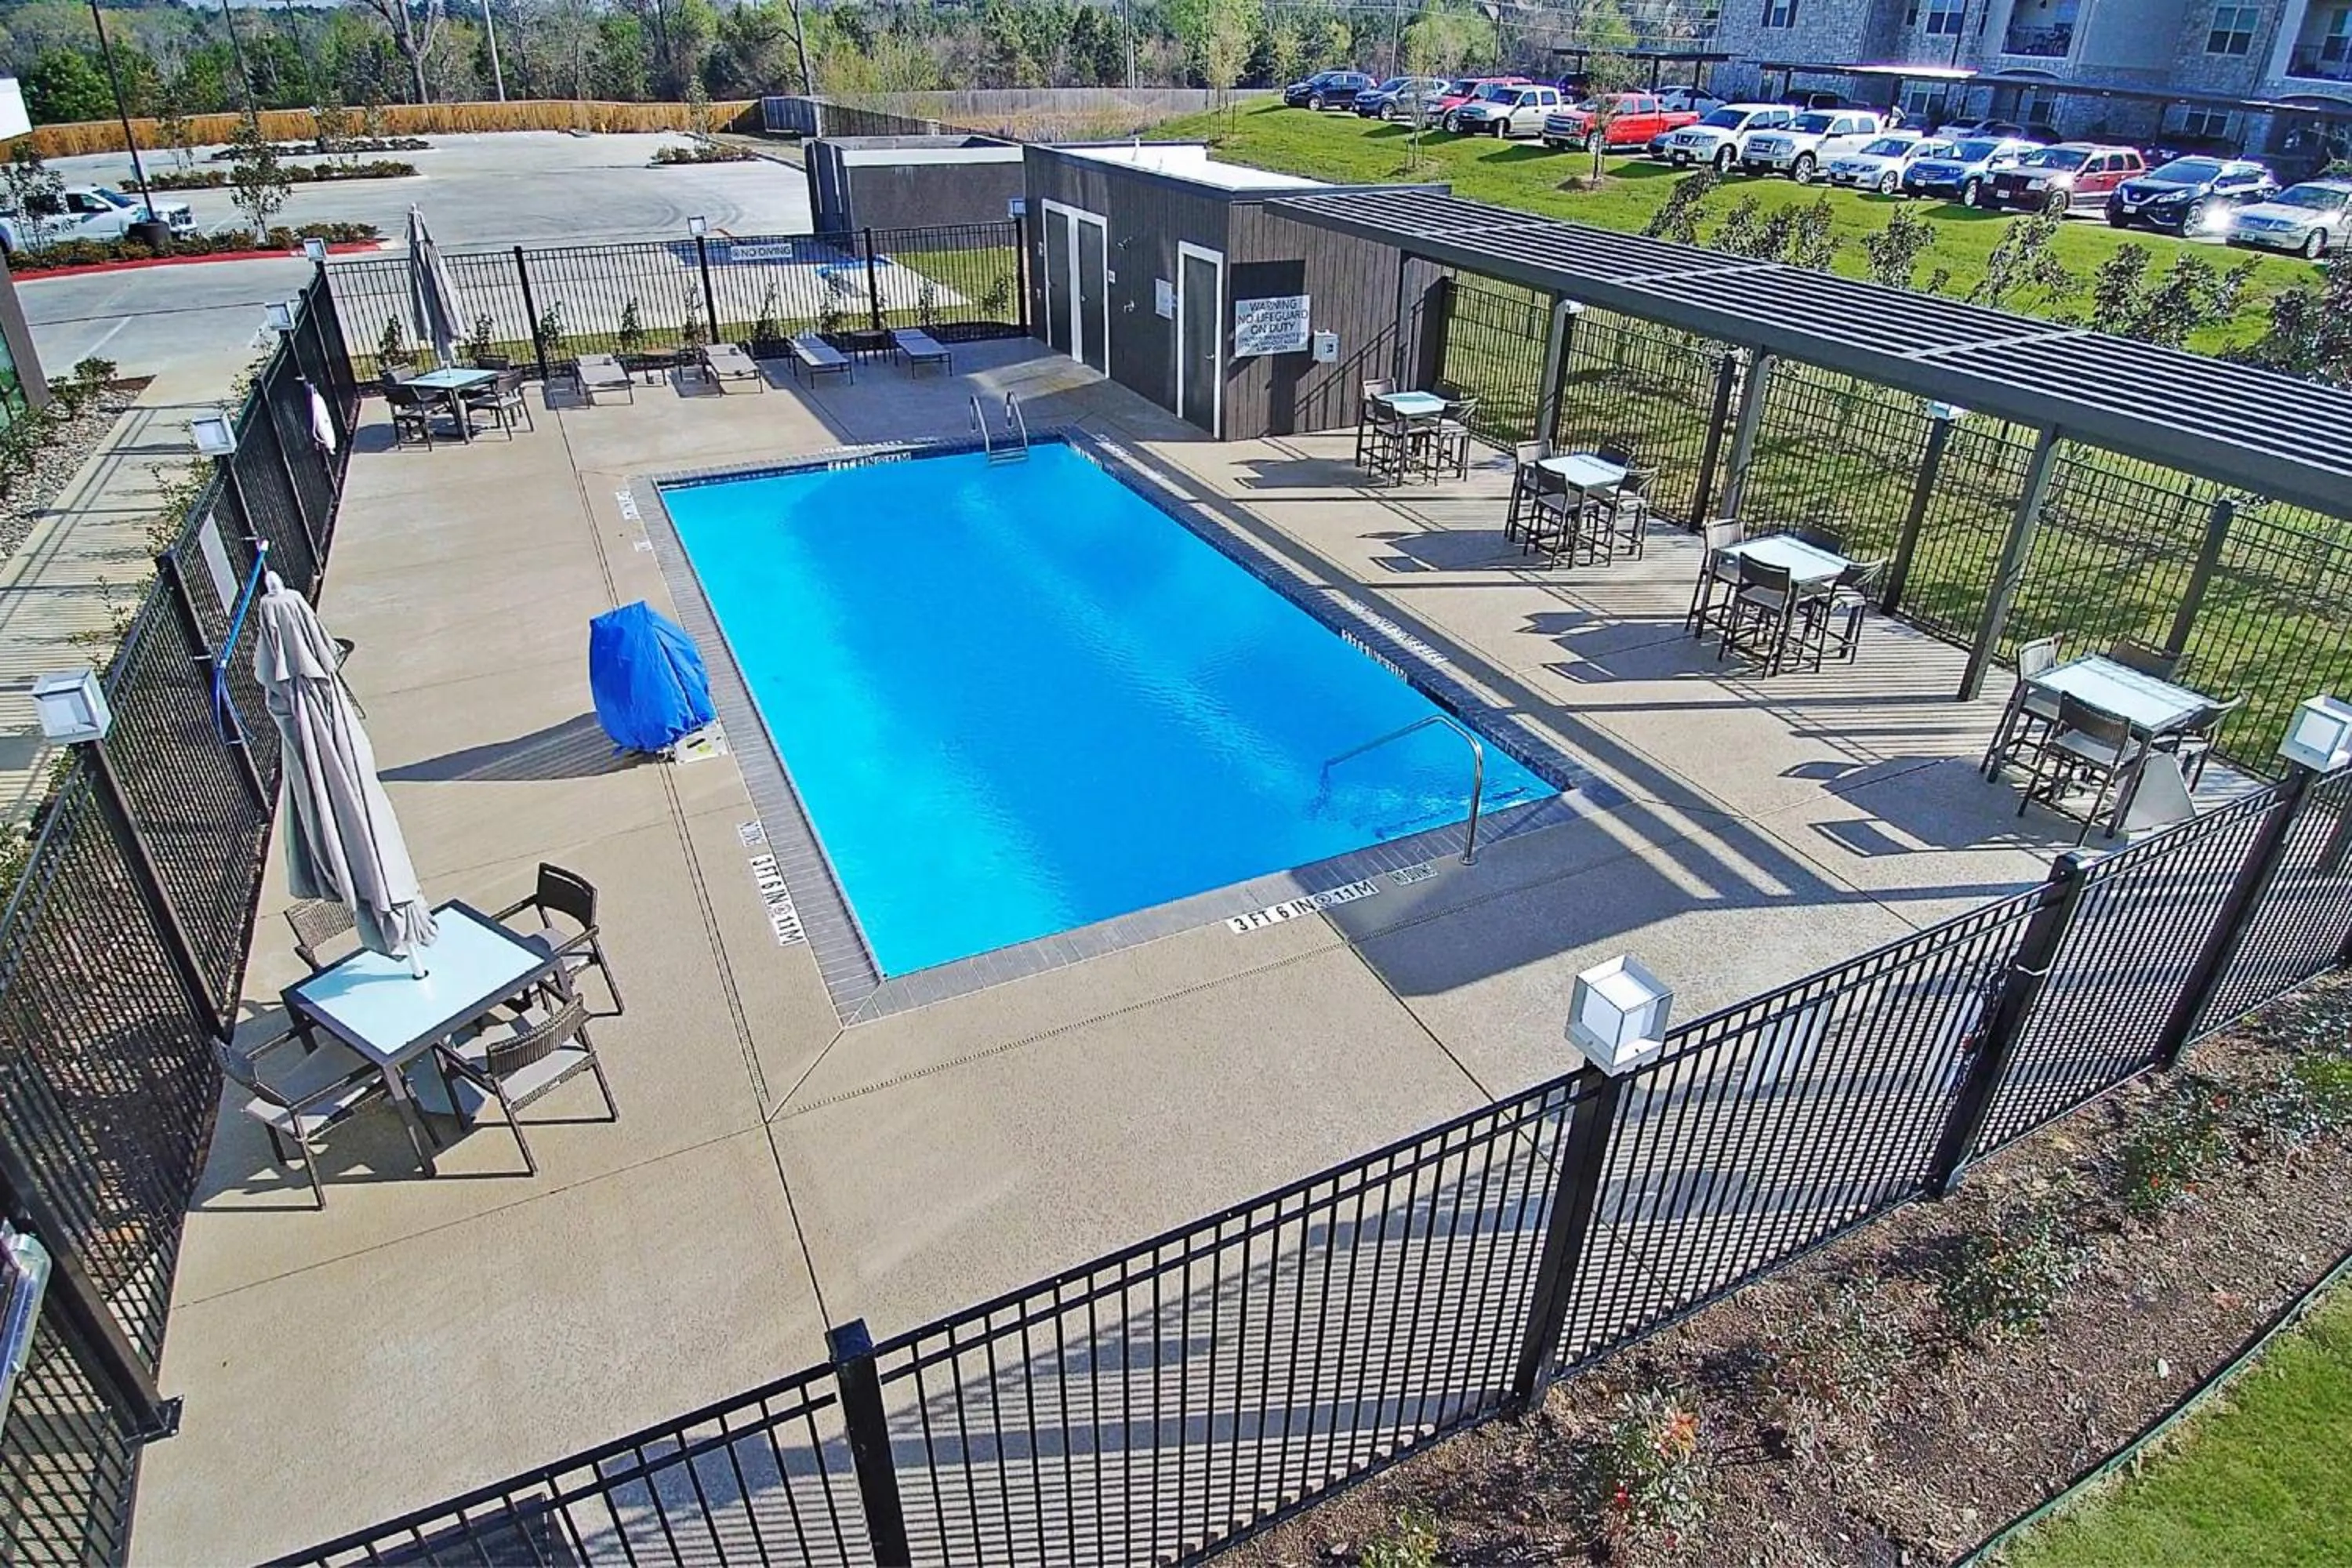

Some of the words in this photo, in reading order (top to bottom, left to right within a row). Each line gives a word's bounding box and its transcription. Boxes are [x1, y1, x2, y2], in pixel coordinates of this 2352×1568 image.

[1249, 299, 1297, 311] WARNING
[1238, 314, 1254, 325] NO
[1257, 310, 1308, 322] LIFEGUARD
[1250, 325, 1266, 335] ON
[1270, 321, 1296, 333] DUTY
[756, 866, 779, 879] FT
[764, 889, 789, 905] IN
[1233, 918, 1249, 931] 3
[1247, 910, 1272, 927] FT
[1276, 906, 1290, 918] 6
[1290, 898, 1316, 914] IN
